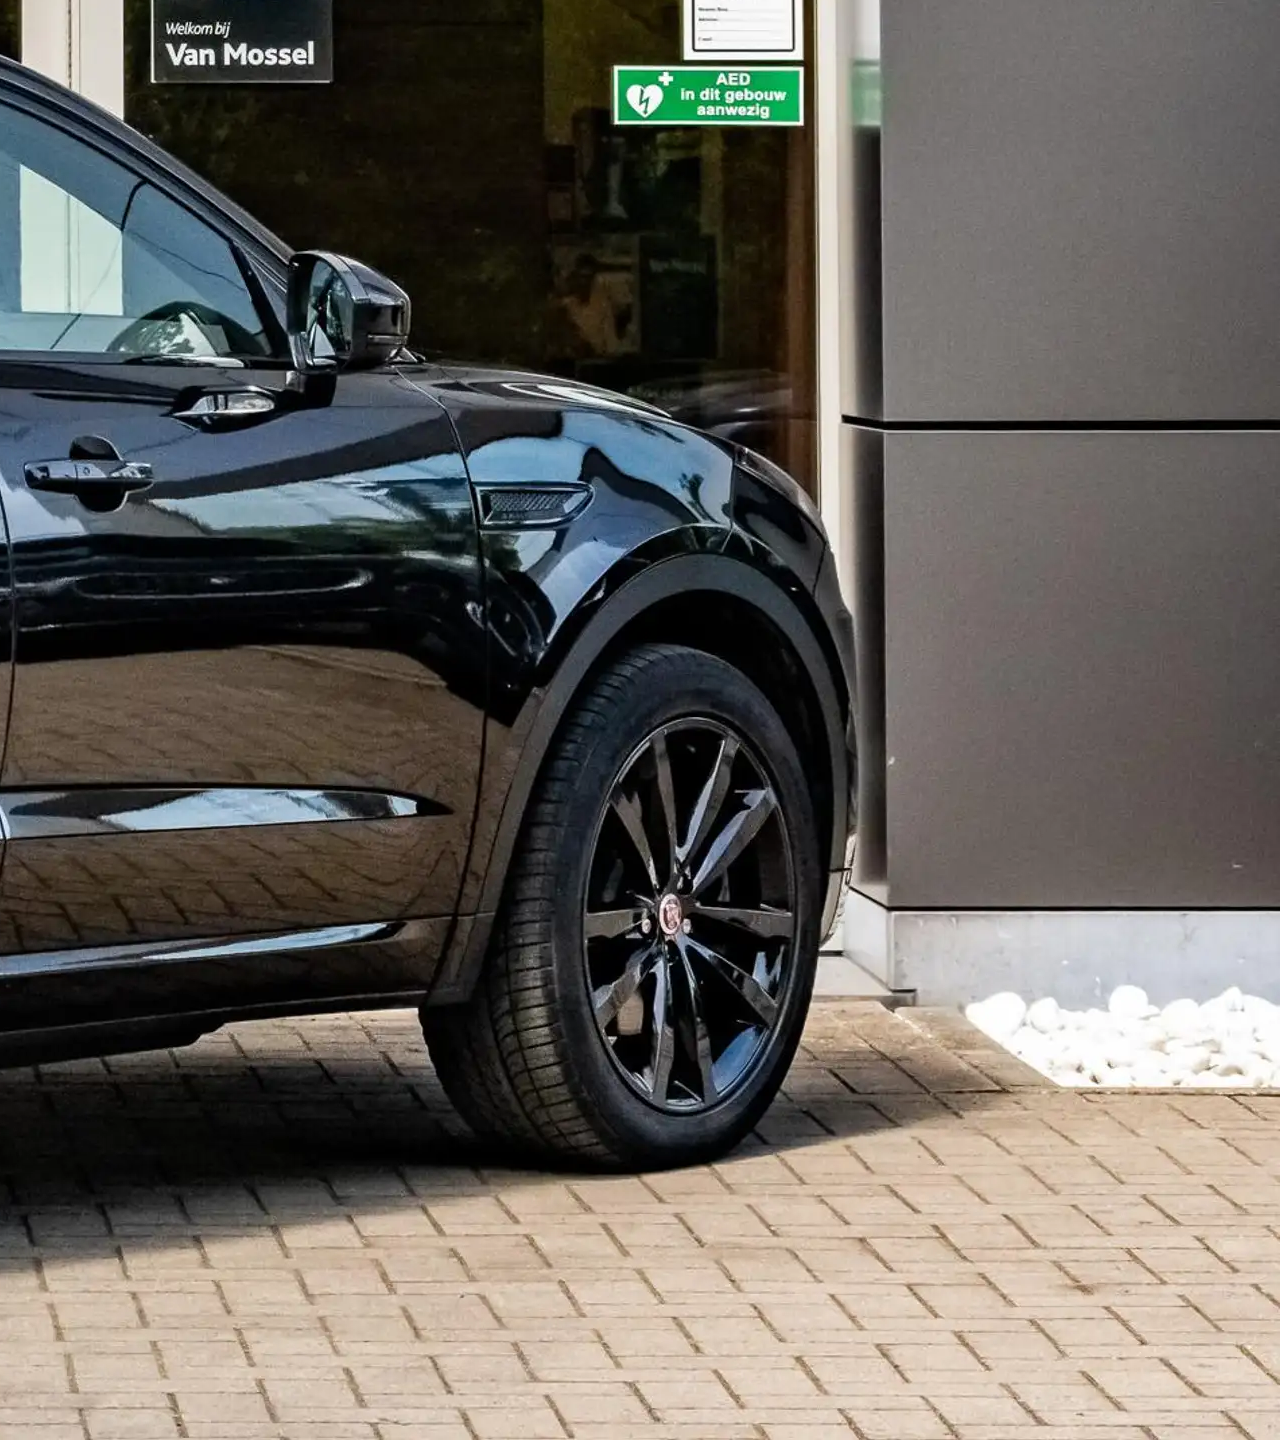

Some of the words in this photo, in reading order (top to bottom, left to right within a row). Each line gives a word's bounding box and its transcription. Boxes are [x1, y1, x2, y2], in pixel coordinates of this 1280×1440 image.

[165, 21, 213, 36] Welkom
[214, 21, 231, 39] bij
[165, 43, 216, 66] Van
[223, 40, 315, 66] Mossel
[715, 72, 751, 86] AED
[680, 88, 695, 101] in
[699, 88, 721, 101] dit
[724, 88, 787, 104] gebouw
[696, 103, 770, 119] aanwezig
